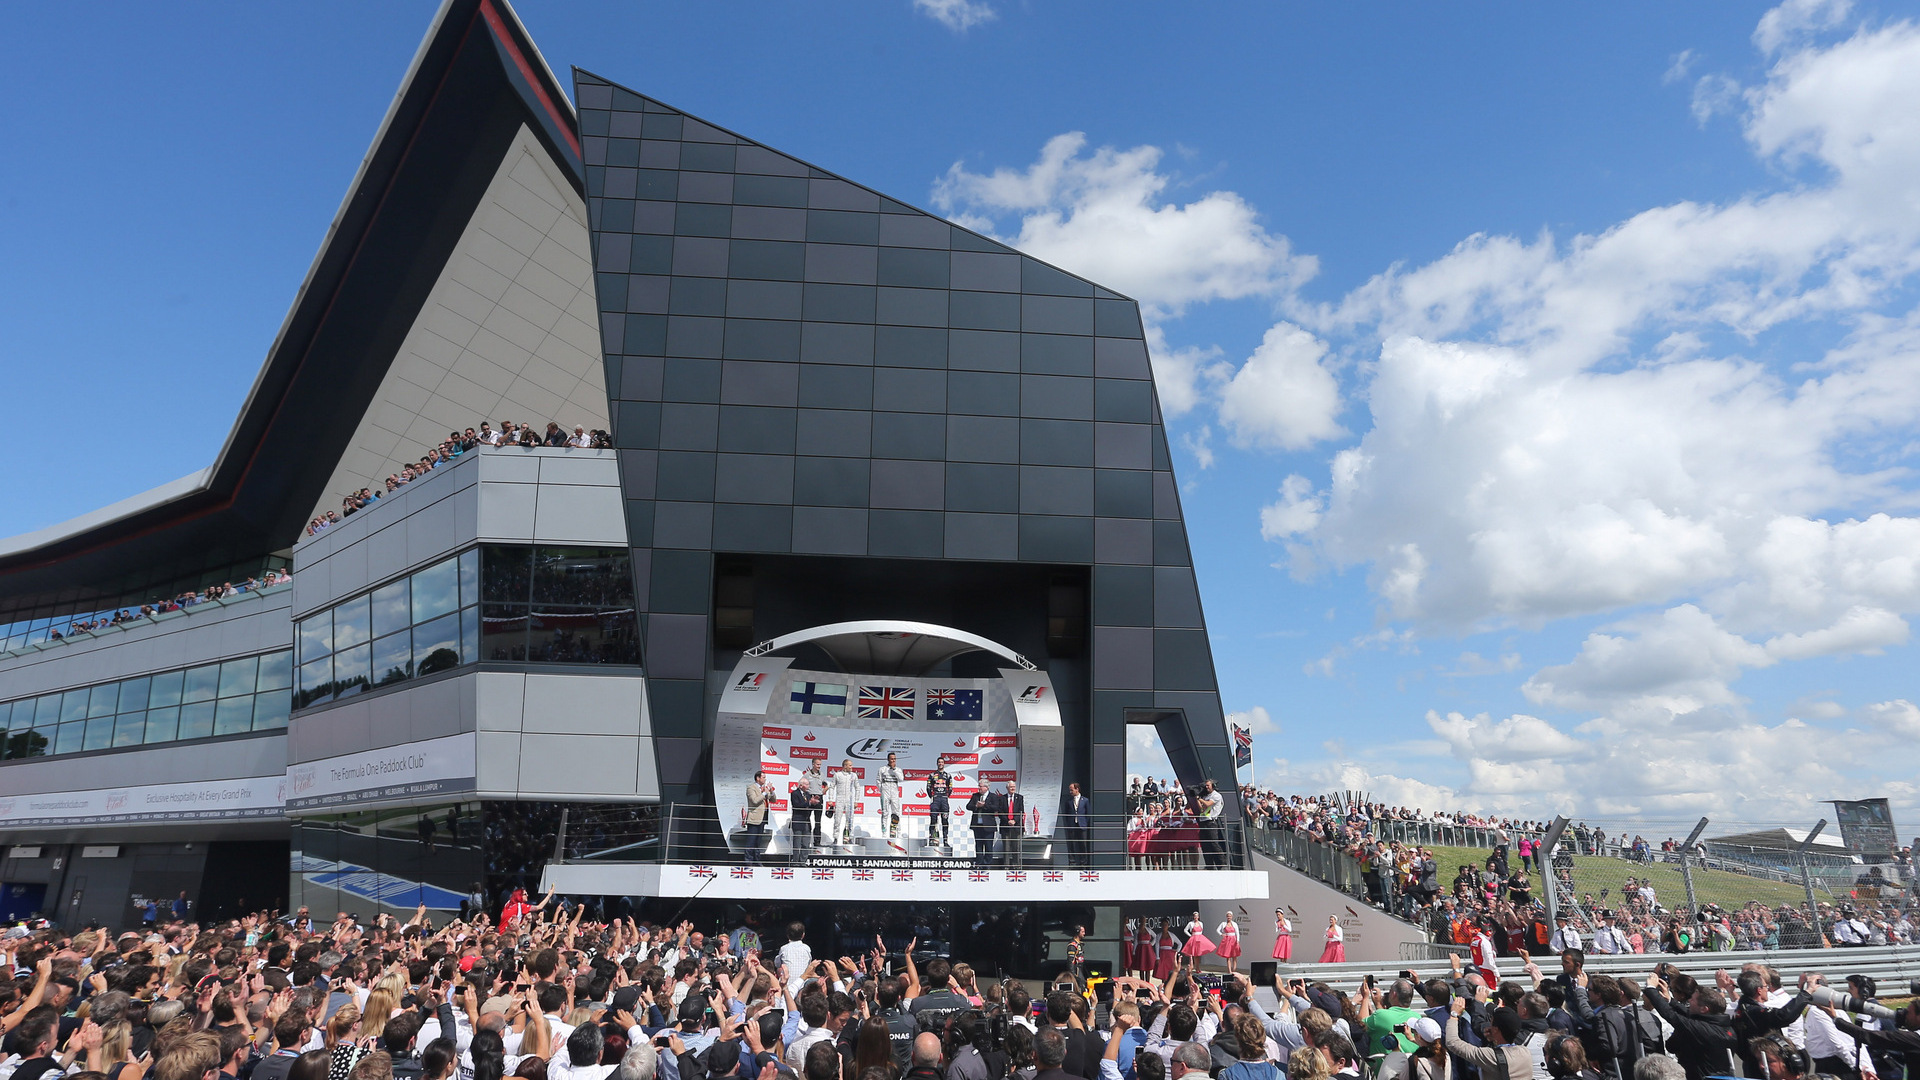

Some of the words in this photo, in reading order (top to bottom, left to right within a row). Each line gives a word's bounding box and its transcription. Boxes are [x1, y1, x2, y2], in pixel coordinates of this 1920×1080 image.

[764, 729, 790, 737] Santander
[800, 749, 826, 757] Santander
[331, 769, 341, 781] The
[342, 764, 365, 780] Formula
[366, 763, 379, 776] One
[380, 757, 407, 773] Paddock
[408, 754, 424, 769] Club
[761, 765, 787, 773] Santander
[146, 793, 169, 803] Exclusive
[170, 792, 197, 805] Hospitality
[198, 792, 205, 800] At
[206, 790, 221, 802] Every
[221, 789, 239, 800] Grand
[241, 788, 252, 799] Prix
[813, 859, 852, 867] FORMULA
[863, 860, 910, 868] SANTANDER
[913, 860, 941, 868] BRITISH
[889, 1032, 910, 1040] ONAS
